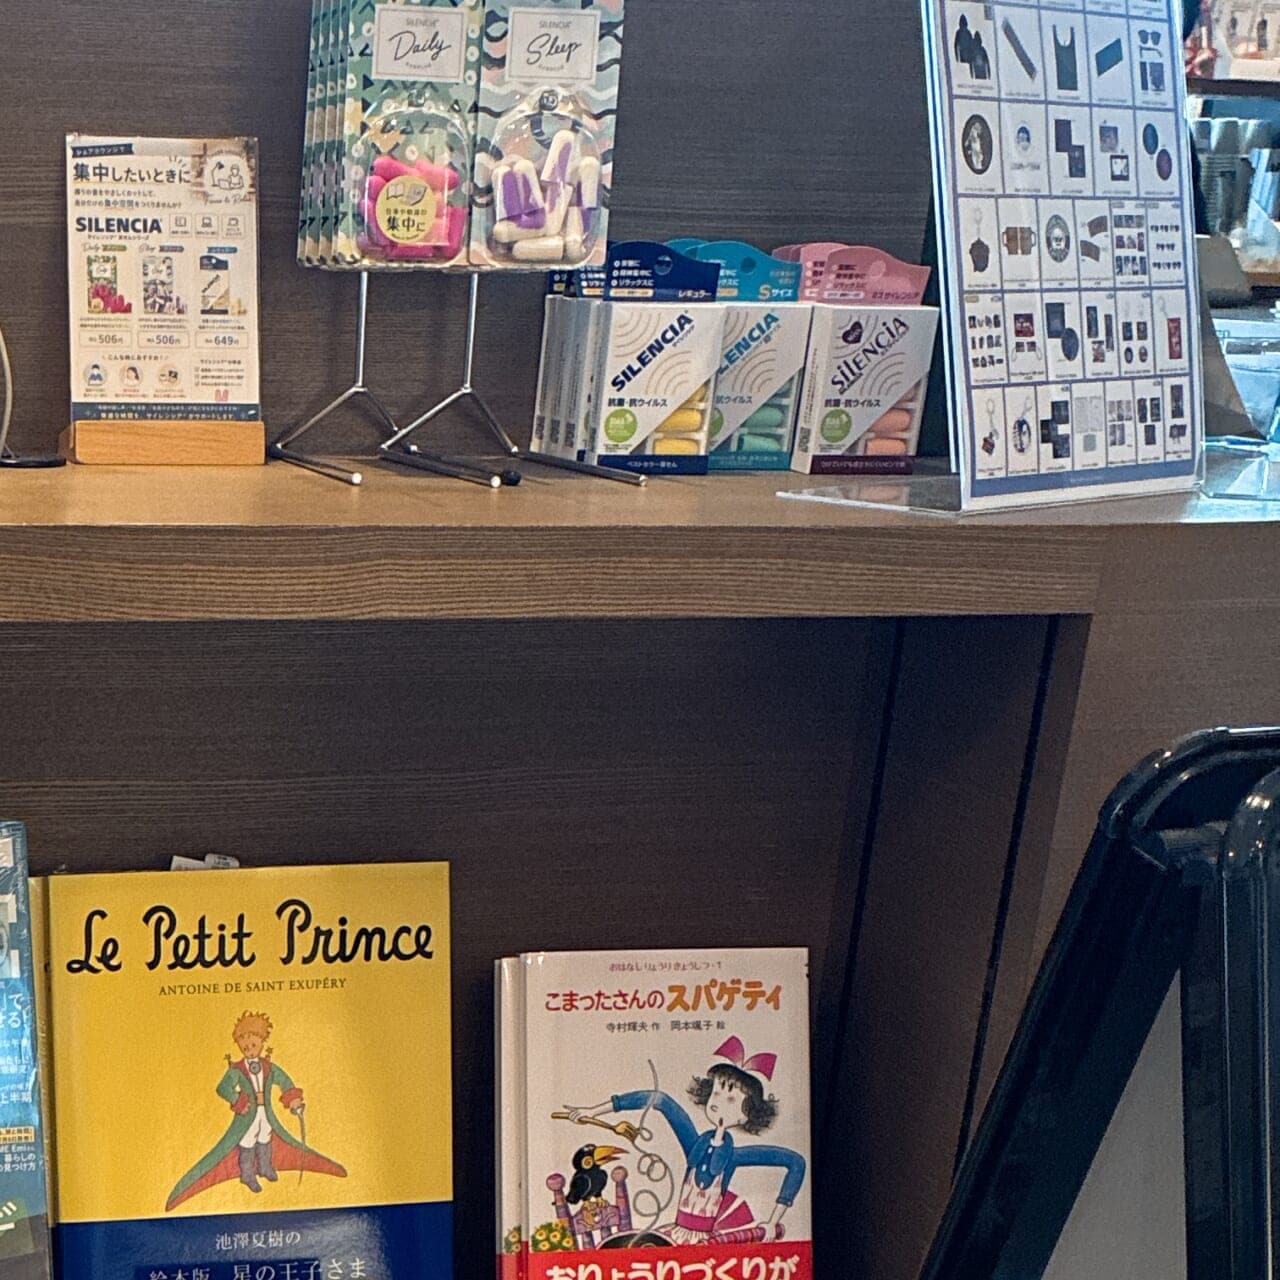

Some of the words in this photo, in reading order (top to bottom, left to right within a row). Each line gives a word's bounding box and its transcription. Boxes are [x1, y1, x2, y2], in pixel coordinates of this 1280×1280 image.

[388, 30, 452, 61] Daily
[526, 33, 581, 65] Sleep
[73, 162, 191, 183] 集中したいときに
[75, 217, 162, 233] SILENCIA
[386, 216, 426, 233] 集中に
[678, 290, 712, 298] レギュラー
[611, 312, 694, 392] SILENCIA
[718, 312, 780, 375] LENCIA
[67, 909, 122, 974] Le
[143, 905, 257, 970] Petit
[277, 899, 434, 966] Prince
[159, 983, 220, 996] ANTOINE
[224, 982, 242, 993] DE
[246, 980, 285, 993] SAINT
[289, 977, 347, 992] EXUPÉRY
[544, 979, 783, 1013] こまったさんのスパゲティ
[606, 1021, 648, 1033] 寺村輝夫
[651, 1022, 660, 1031] 作
[215, 1230, 301, 1251] 池澤夏樹の
